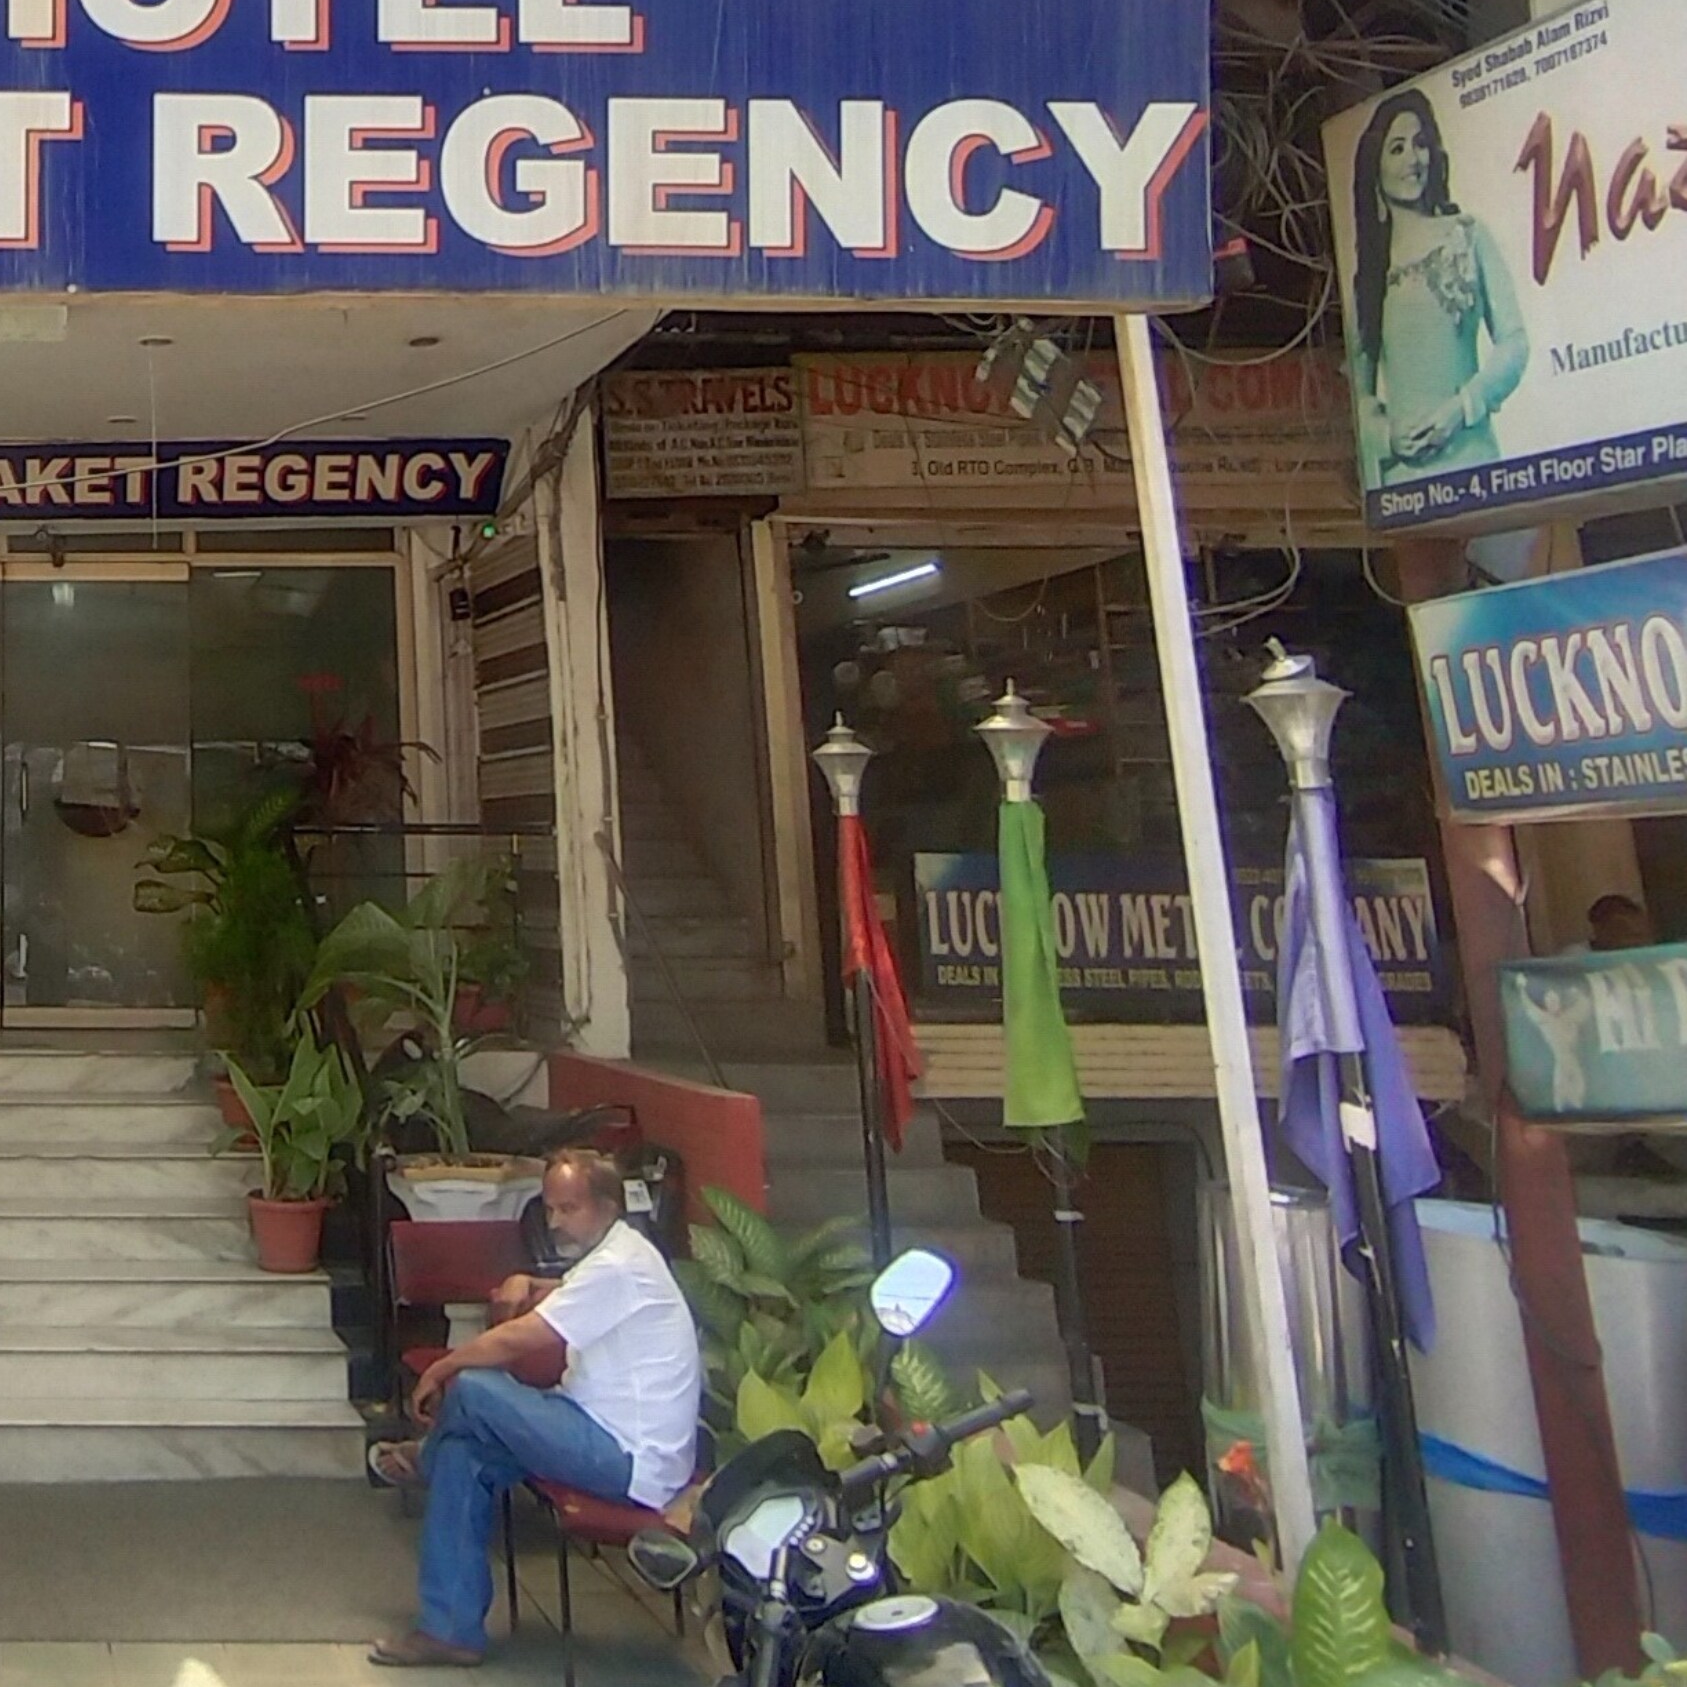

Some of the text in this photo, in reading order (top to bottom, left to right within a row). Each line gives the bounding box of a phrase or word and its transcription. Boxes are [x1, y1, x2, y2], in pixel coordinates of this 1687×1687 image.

[1536, 22, 1571, 50] Alam
[151, 90, 1208, 261] REGENCY
[176, 451, 498, 505] REGENCY
[928, 460, 953, 476] Old
[958, 460, 989, 476] RTO
[1380, 478, 1424, 516] Shop
[1490, 461, 1536, 495] First
[1540, 453, 1595, 488] Floor
[1599, 442, 1644, 474] Star
[1651, 433, 1687, 460] Pla
[1431, 616, 1687, 754] LUCKNO
[1465, 765, 1534, 800] DEALS
[1537, 762, 1564, 793] IN
[925, 890, 1109, 958] LUCOW
